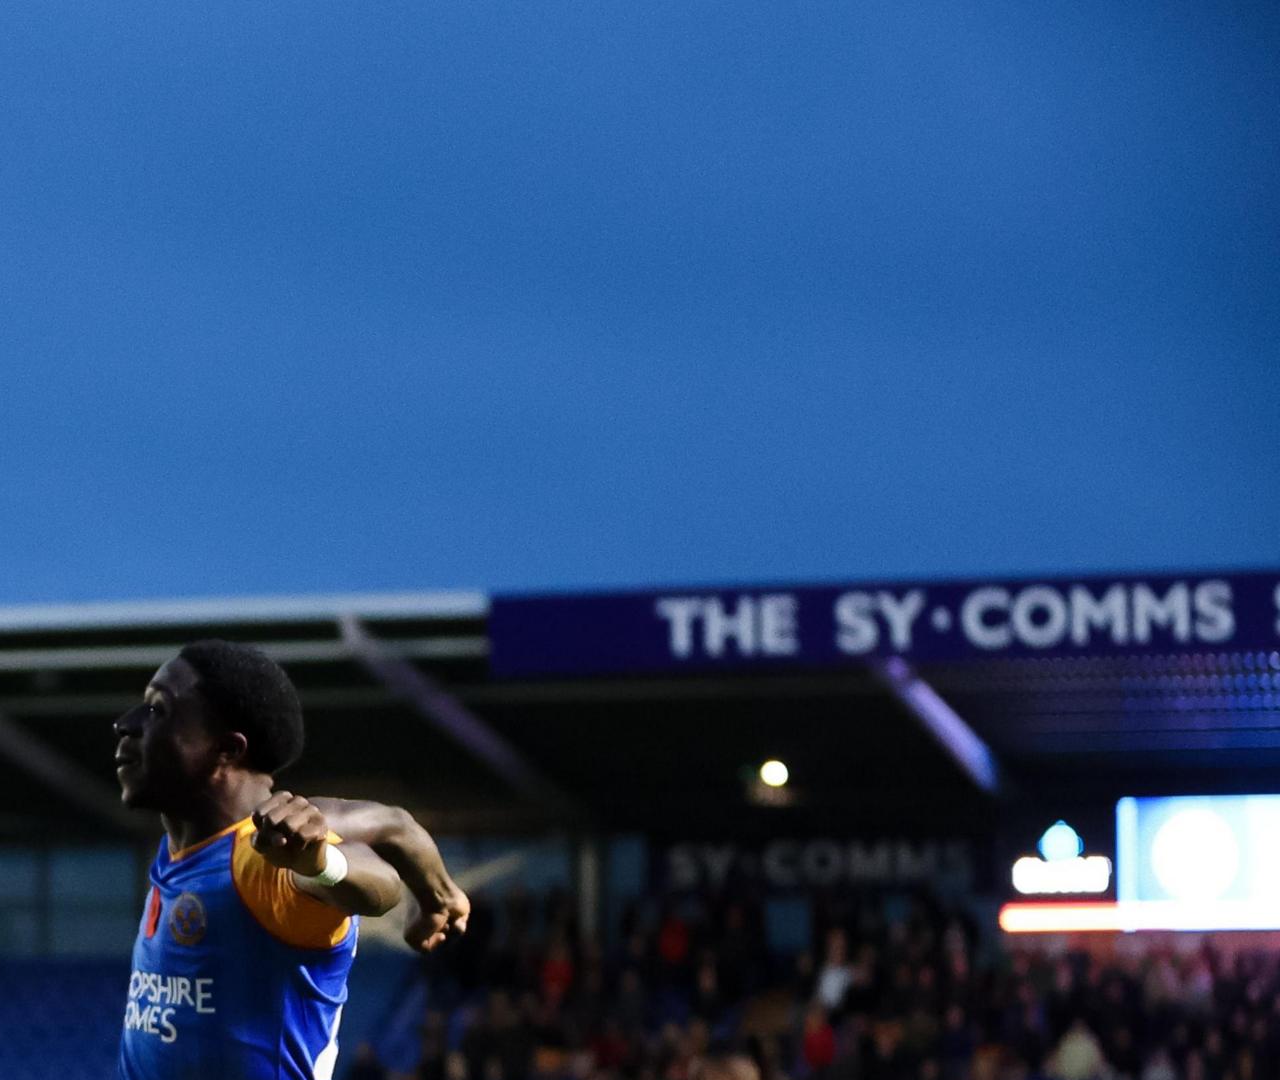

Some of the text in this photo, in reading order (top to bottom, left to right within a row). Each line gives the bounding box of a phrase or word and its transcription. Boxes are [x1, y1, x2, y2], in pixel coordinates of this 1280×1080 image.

[656, 594, 798, 658] THE
[128, 970, 216, 1013] OPSHIRE
[125, 1001, 177, 1043] OMES
